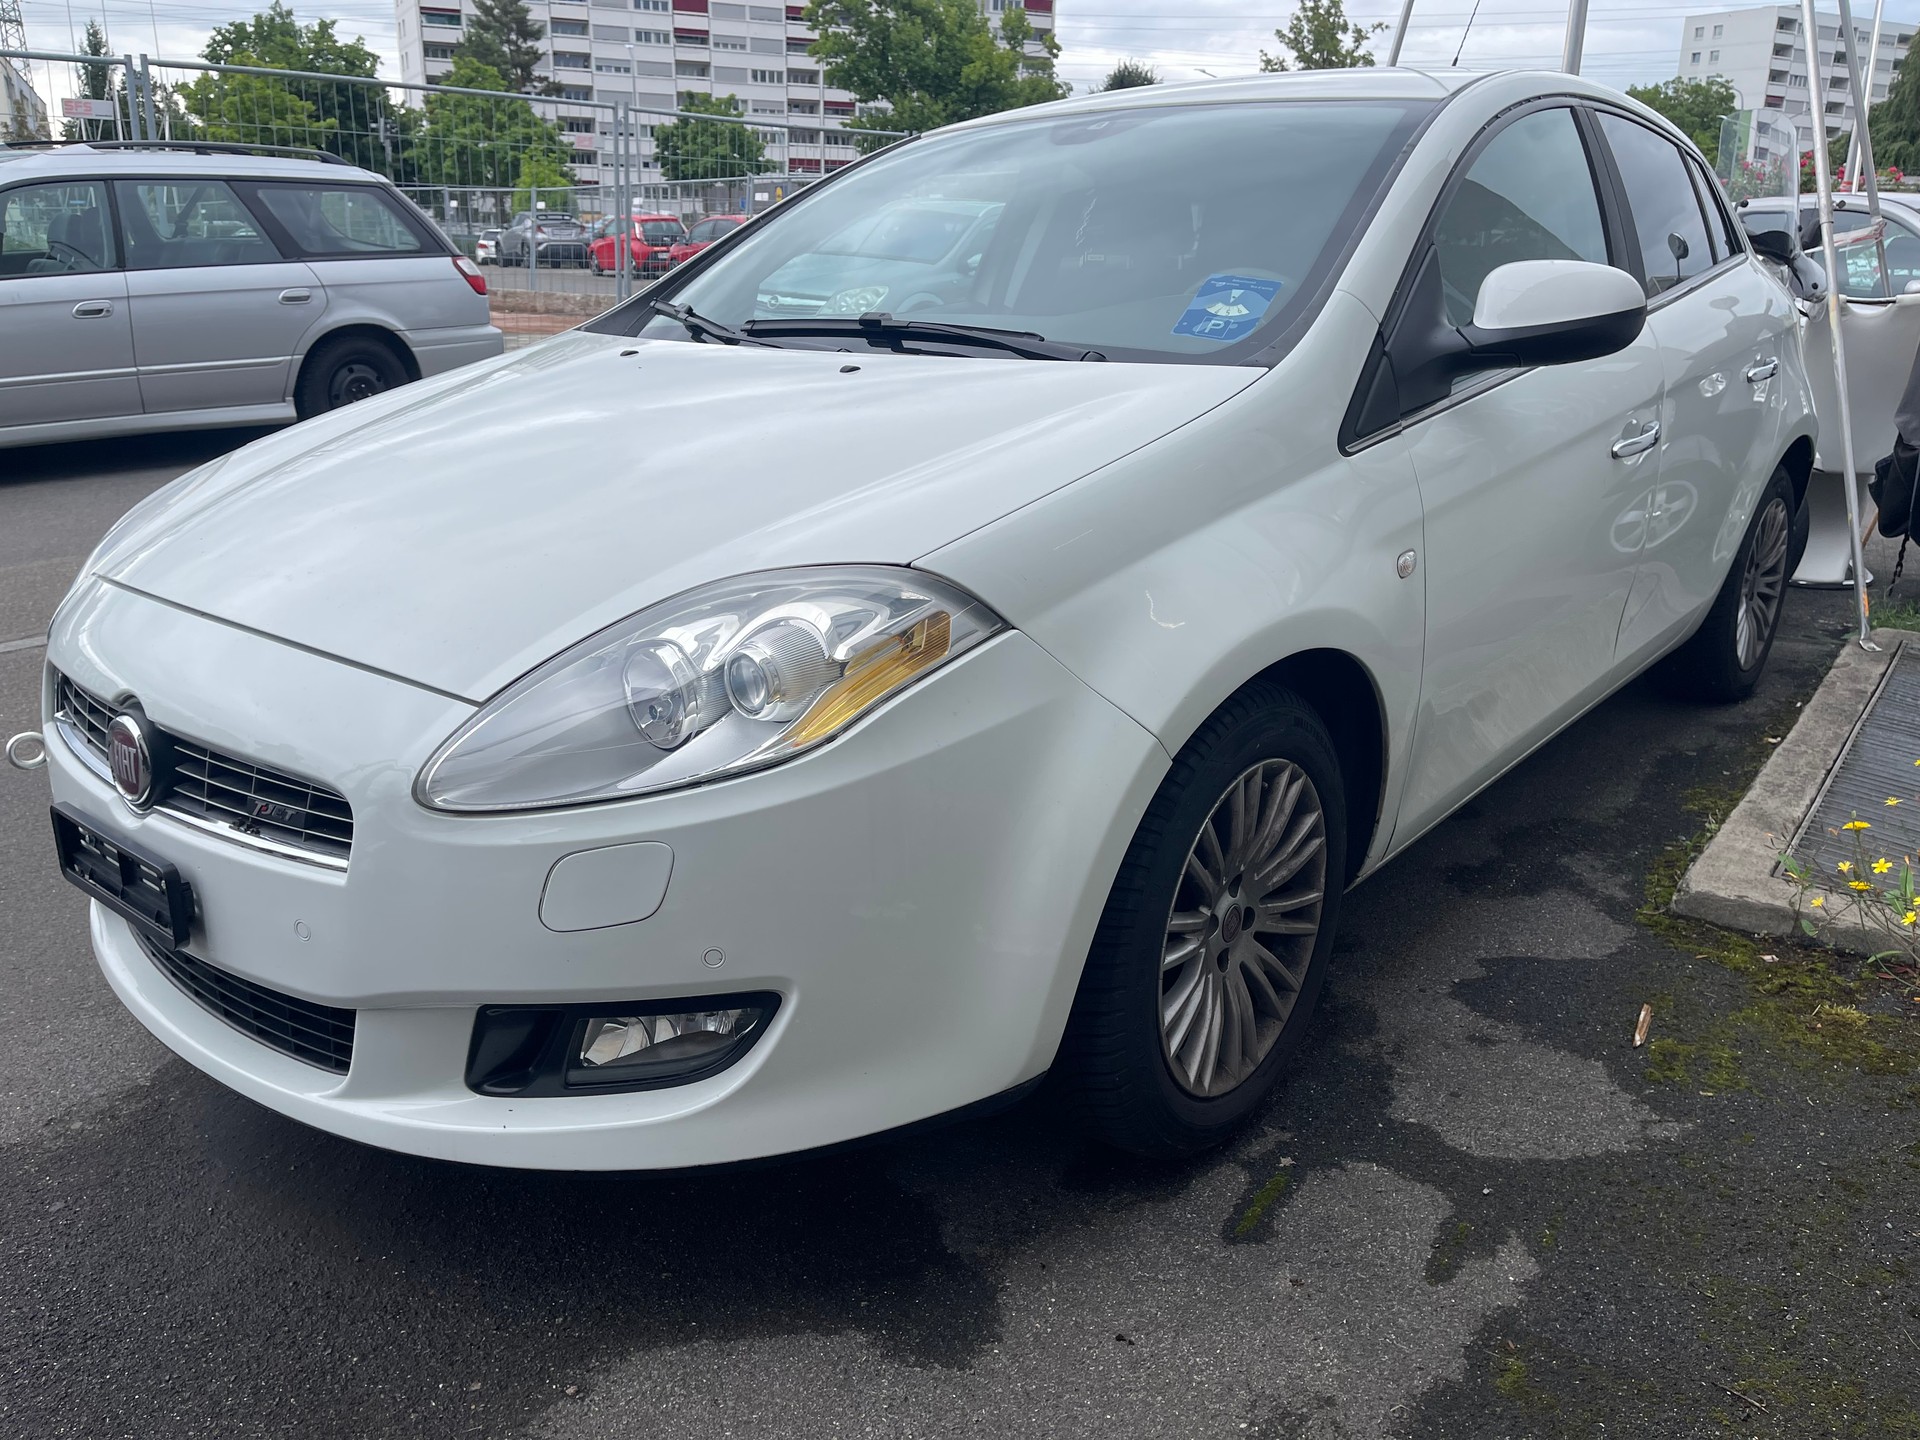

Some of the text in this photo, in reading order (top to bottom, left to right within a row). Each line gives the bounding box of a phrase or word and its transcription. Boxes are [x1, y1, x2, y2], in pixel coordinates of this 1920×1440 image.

[64, 100, 92, 113] SFS
[1204, 319, 1226, 333] P
[113, 738, 137, 785] FIAT
